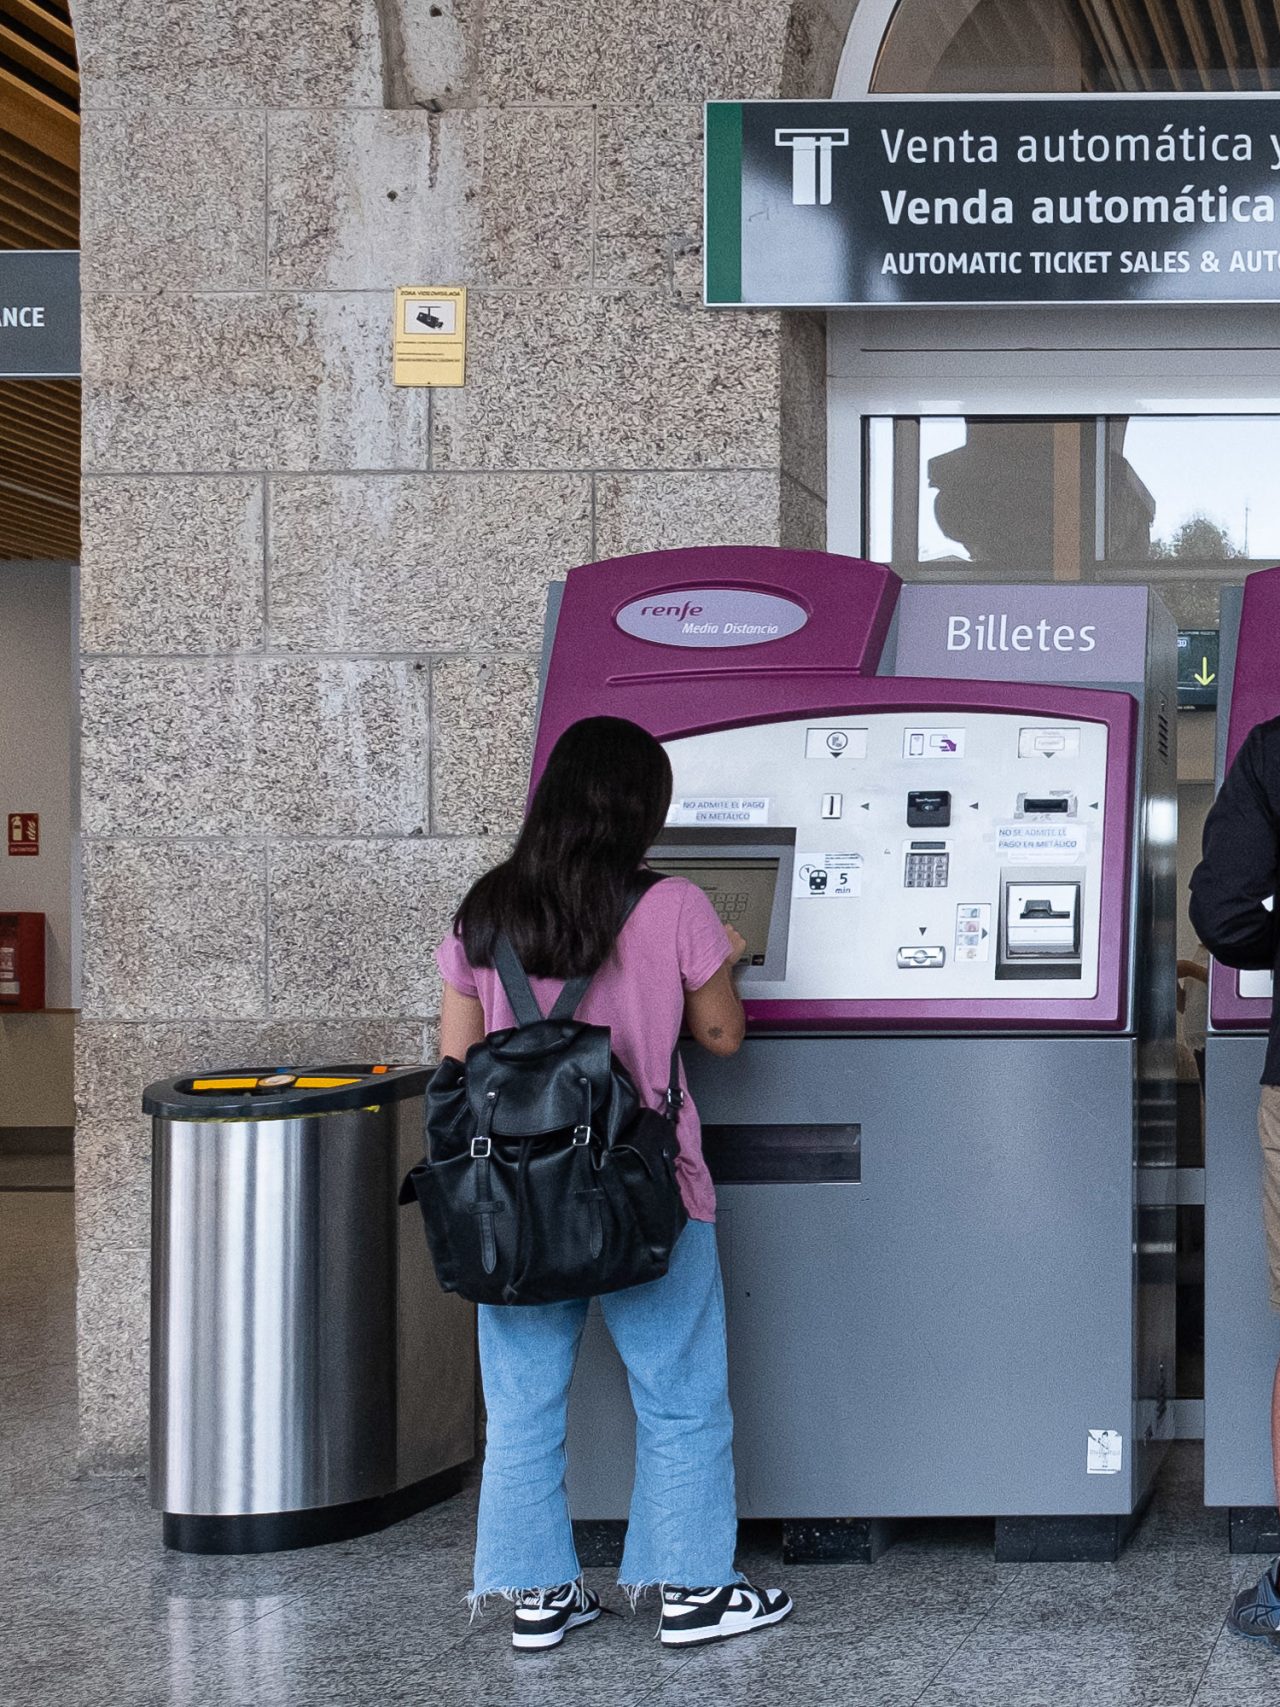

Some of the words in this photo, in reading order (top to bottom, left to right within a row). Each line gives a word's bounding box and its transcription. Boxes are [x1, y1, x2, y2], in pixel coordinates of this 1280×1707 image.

[881, 128, 998, 164] Venta
[1017, 124, 1253, 163] automática
[880, 189, 1014, 225] Venda
[1031, 185, 1275, 224] automática
[881, 251, 1022, 275] AUTOMATIC
[1029, 250, 1112, 274] TICKET
[1119, 250, 1190, 274] SALES
[1200, 250, 1221, 273] &
[0, 307, 45, 327] NCE
[641, 600, 703, 622] renfe
[681, 622, 718, 635] Media
[723, 622, 779, 635] Distancia
[946, 614, 1097, 652] Billetes
[835, 886, 851, 894] min
[839, 872, 848, 886] 5
